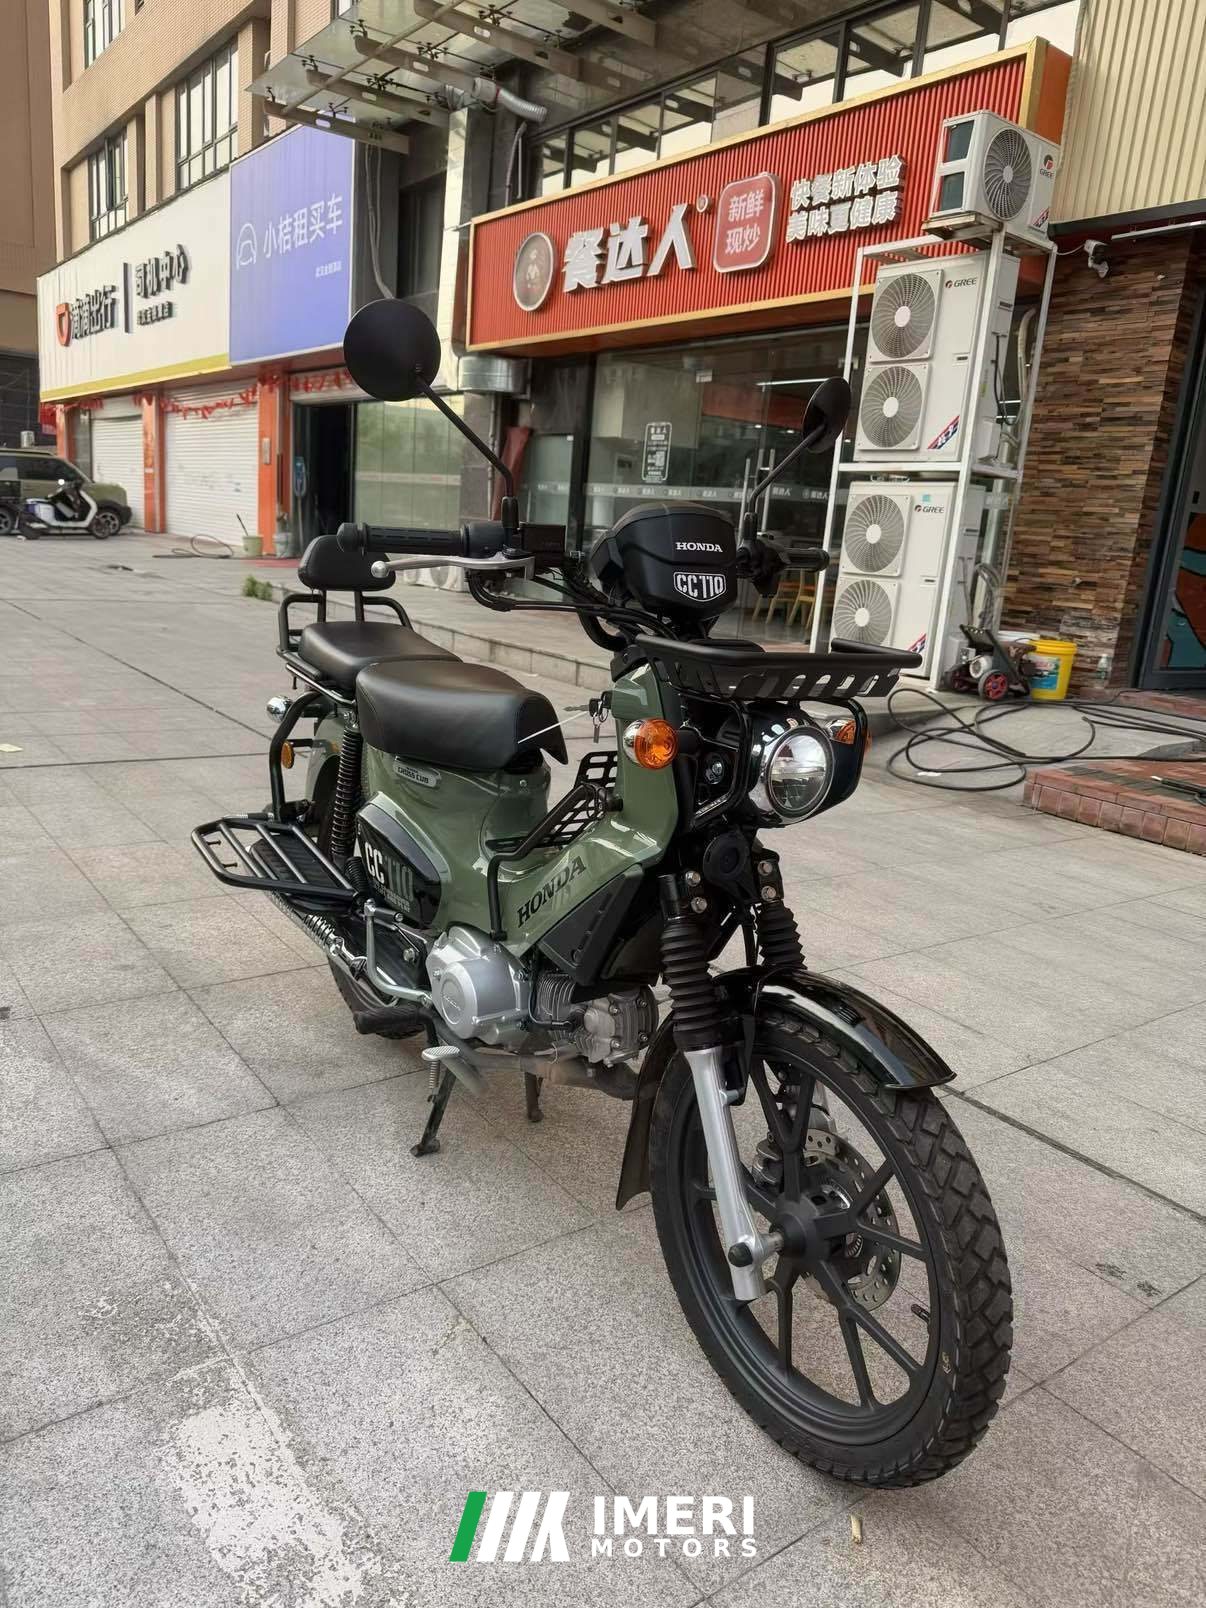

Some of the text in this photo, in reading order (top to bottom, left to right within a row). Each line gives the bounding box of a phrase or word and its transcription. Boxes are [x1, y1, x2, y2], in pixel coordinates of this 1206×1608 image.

[727, 189, 765, 222] 新鲜
[790, 153, 902, 211] 快餐新体验
[263, 192, 343, 259] 小桔租买车
[724, 223, 761, 254] 现炒
[785, 191, 898, 243] 美味更健康
[135, 244, 189, 299] 司机中心
[562, 203, 696, 293] 餐达人
[953, 277, 977, 287] GREE
[71, 284, 118, 340] 滴滴出行
[922, 505, 945, 514] GREE
[676, 541, 723, 553] HONDA
[677, 574, 724, 599] CC110
[364, 842, 413, 902] CC110
[516, 855, 587, 928] HONDA
